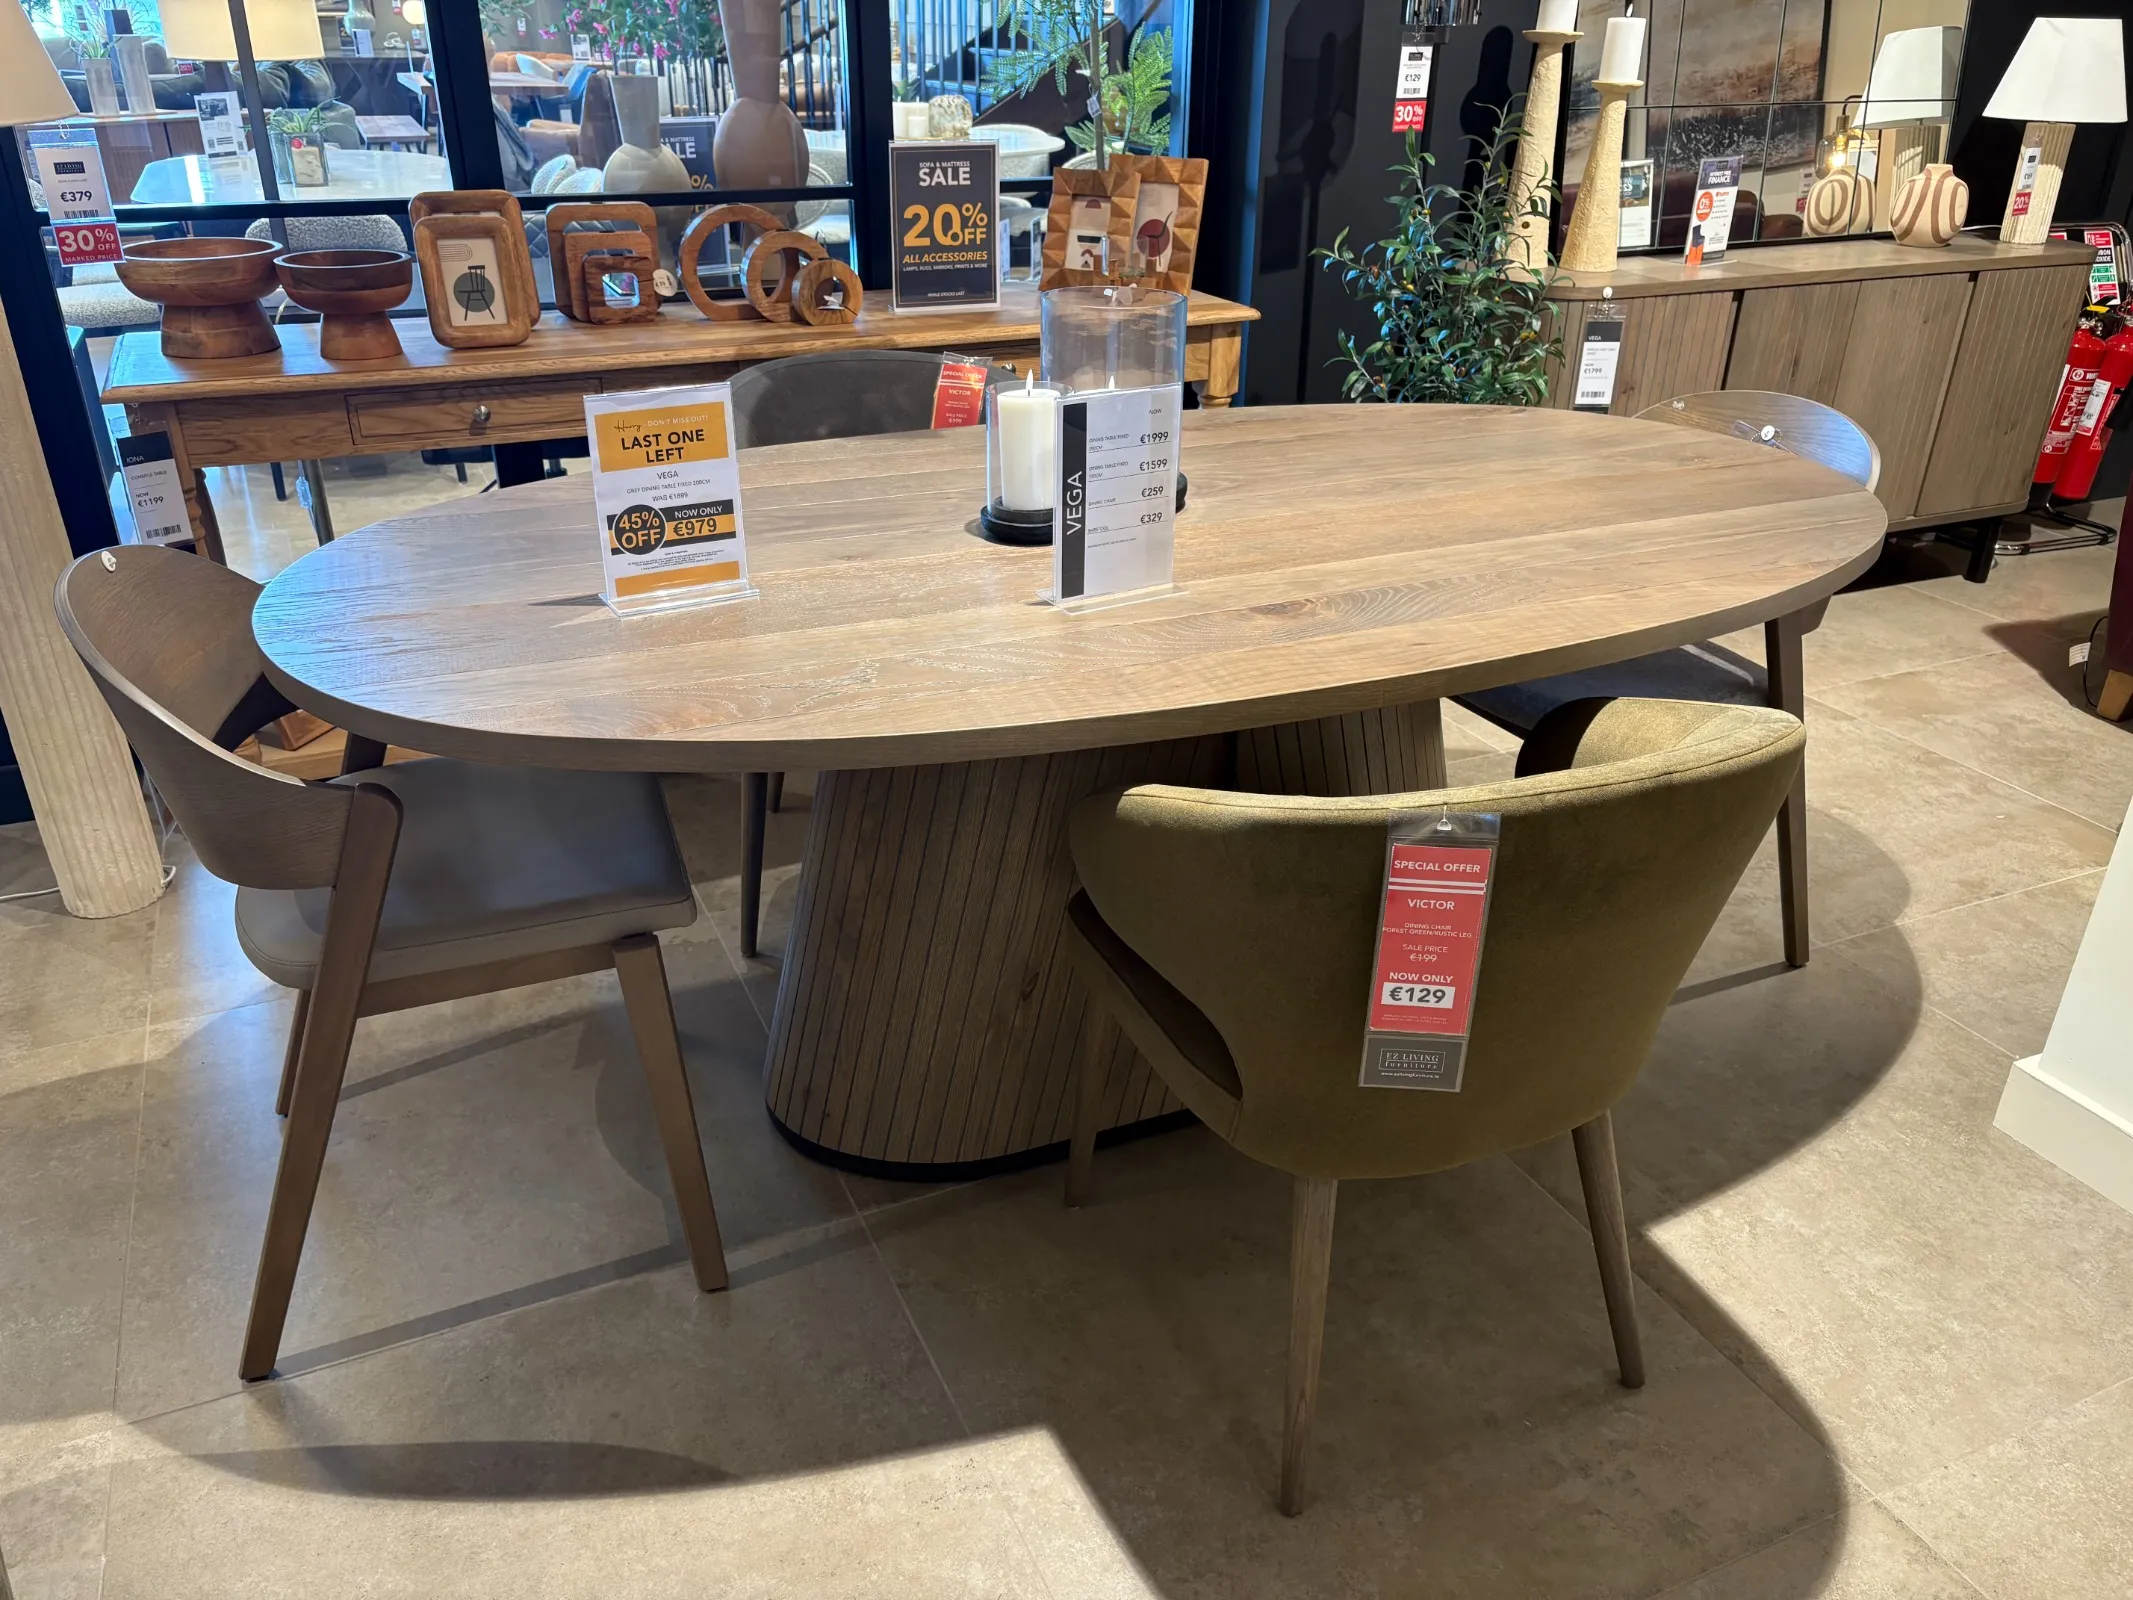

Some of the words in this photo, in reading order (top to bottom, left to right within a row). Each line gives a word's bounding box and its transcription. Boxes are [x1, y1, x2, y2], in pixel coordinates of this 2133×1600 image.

[1405, 74, 1421, 82] €129
[918, 168, 970, 186] SALE
[1708, 176, 1731, 184] FINANCE
[60, 191, 92, 202] €379
[903, 202, 988, 247] 20%
[948, 228, 986, 246] OFF
[59, 228, 114, 252] 30%
[903, 254, 920, 264] ALL
[922, 251, 988, 262] ACCESSORIES
[673, 416, 689, 424] MISS
[621, 434, 662, 450] LAST
[668, 429, 705, 445] ONE
[1140, 431, 1169, 444] €1999
[646, 447, 684, 463] LEFT
[1140, 458, 1168, 471] €1599
[657, 470, 679, 480] VEGA
[1142, 486, 1164, 498] €259
[138, 496, 164, 507] €1199
[1066, 471, 1082, 535] VEGA
[619, 510, 660, 530] 45%
[674, 508, 698, 519] NOW
[700, 505, 723, 516] ONLY
[1140, 512, 1163, 524] €329
[622, 529, 661, 549] OFF
[673, 518, 717, 537] €979
[1394, 860, 1440, 871] SPECIAL
[1444, 863, 1481, 873] OFFER
[1408, 899, 1454, 910] VICTOR
[1409, 929, 1458, 937] GREEN/RUSTIC
[1410, 953, 1437, 962] €199
[1389, 972, 1419, 981] NOW
[1422, 974, 1454, 983] ONLY
[1389, 986, 1446, 1004] €129
[1386, 1052, 1399, 1060] EZ
[1403, 1054, 1439, 1062] LIVING
